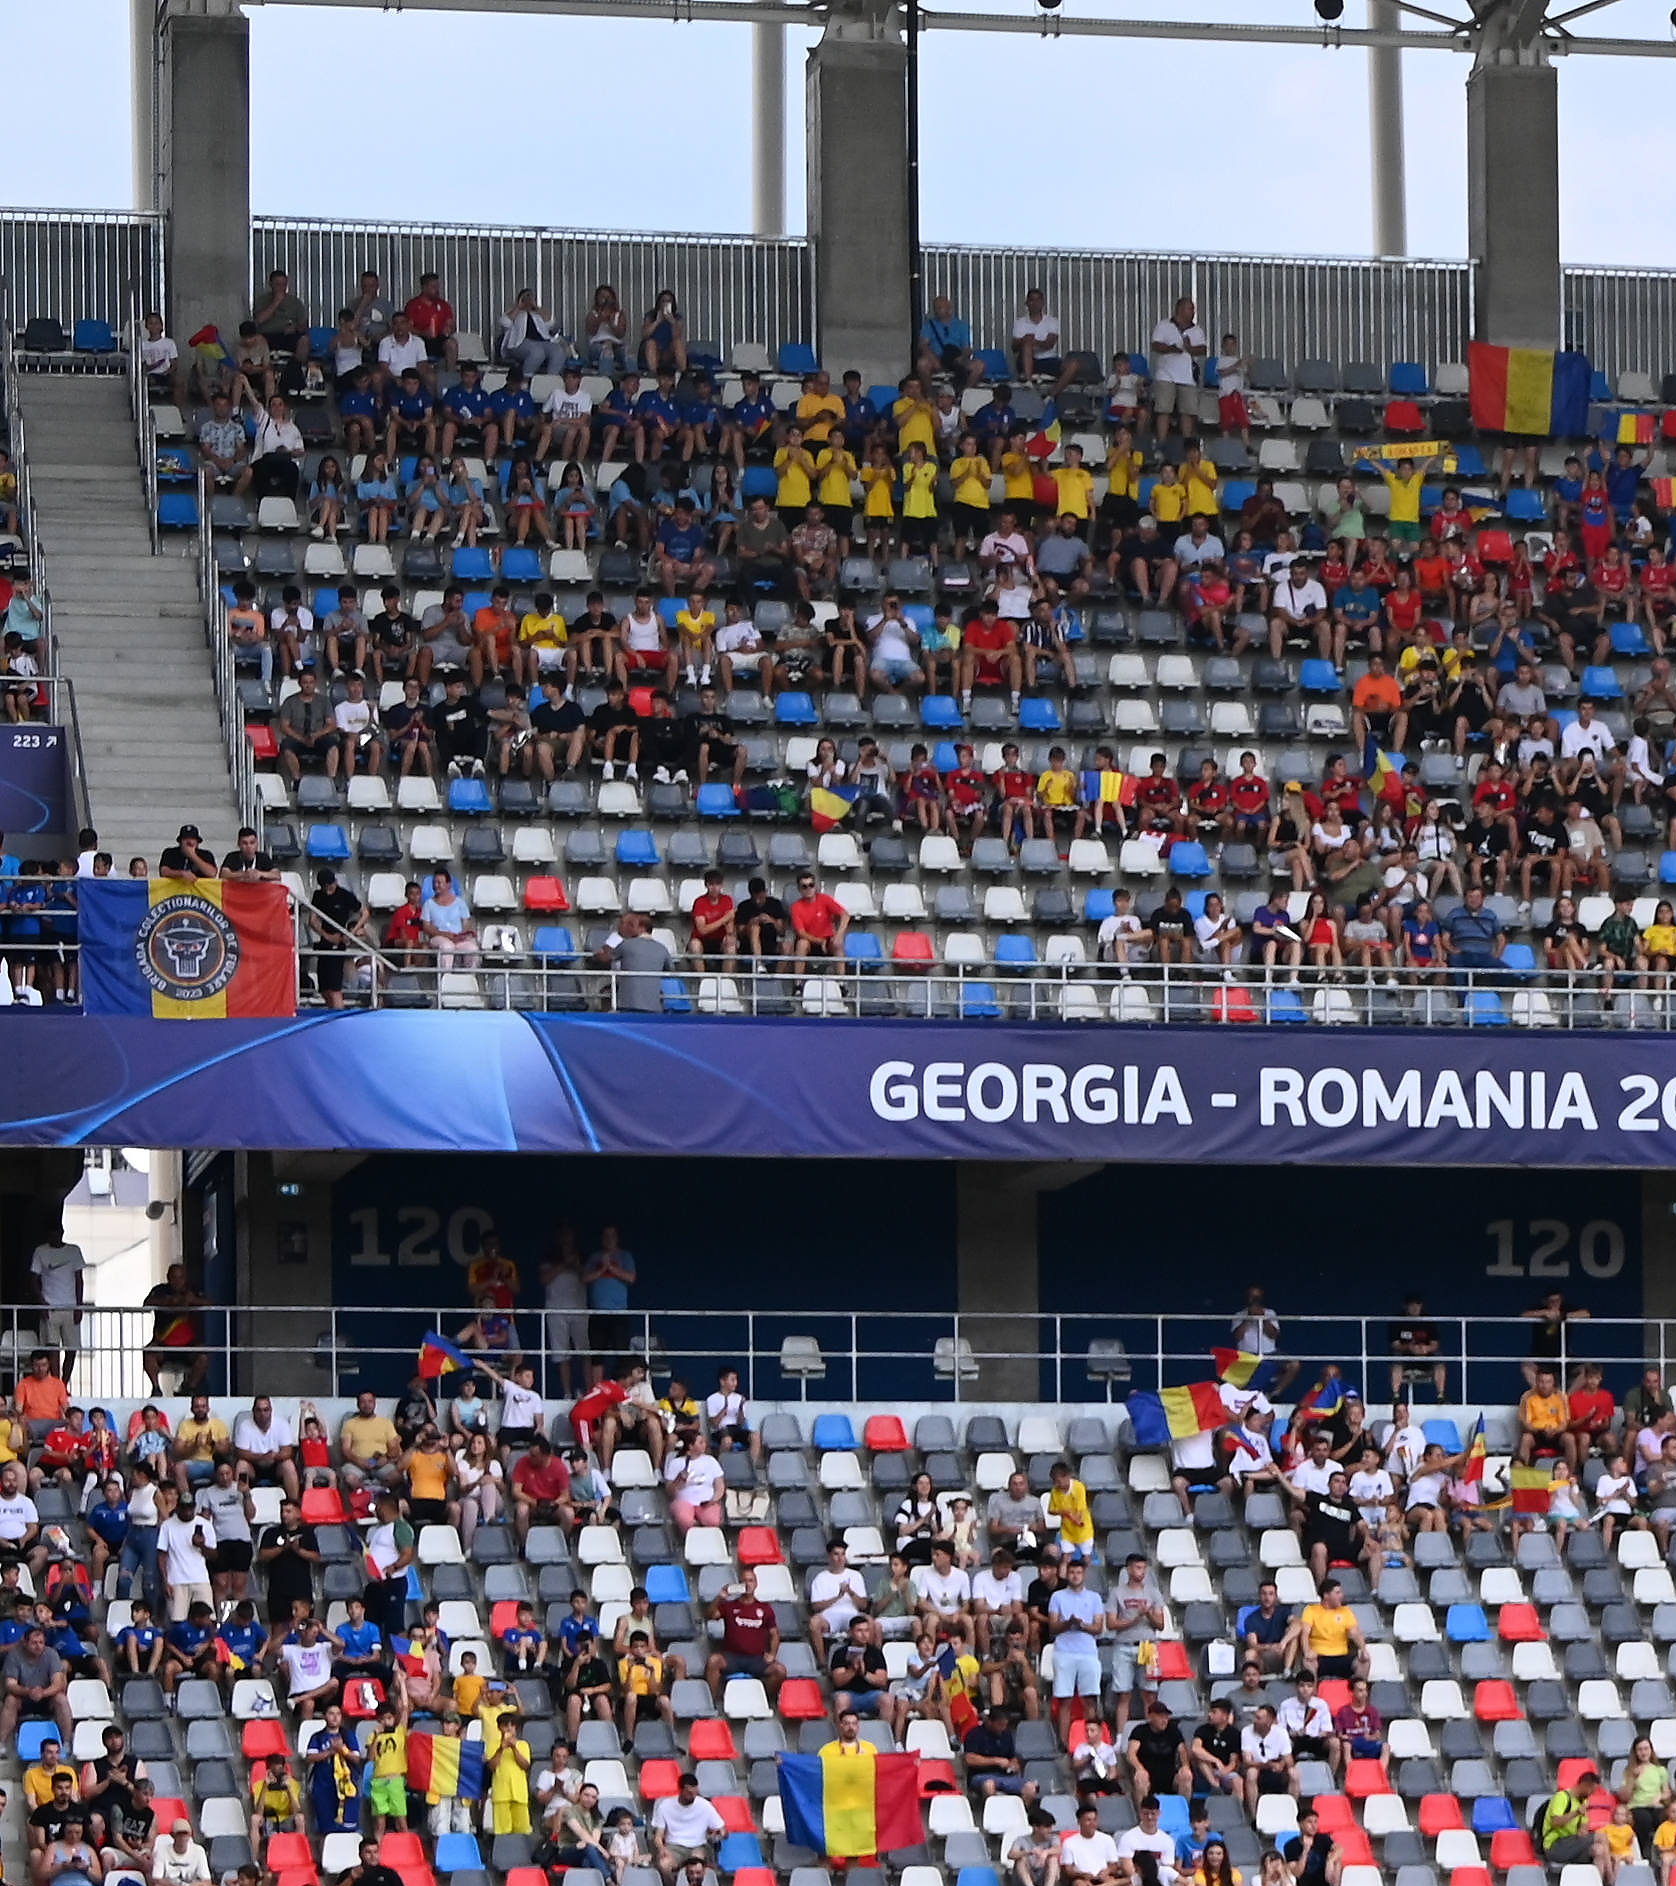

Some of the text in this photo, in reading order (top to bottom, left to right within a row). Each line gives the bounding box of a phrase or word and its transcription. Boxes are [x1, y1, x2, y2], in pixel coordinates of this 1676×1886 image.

[13, 734, 40, 748] 223
[869, 1060, 1193, 1125] GEORGIA
[1260, 1067, 1599, 1131] ROMANIA
[350, 1206, 494, 1267] 120
[1485, 1218, 1626, 1279] 120
